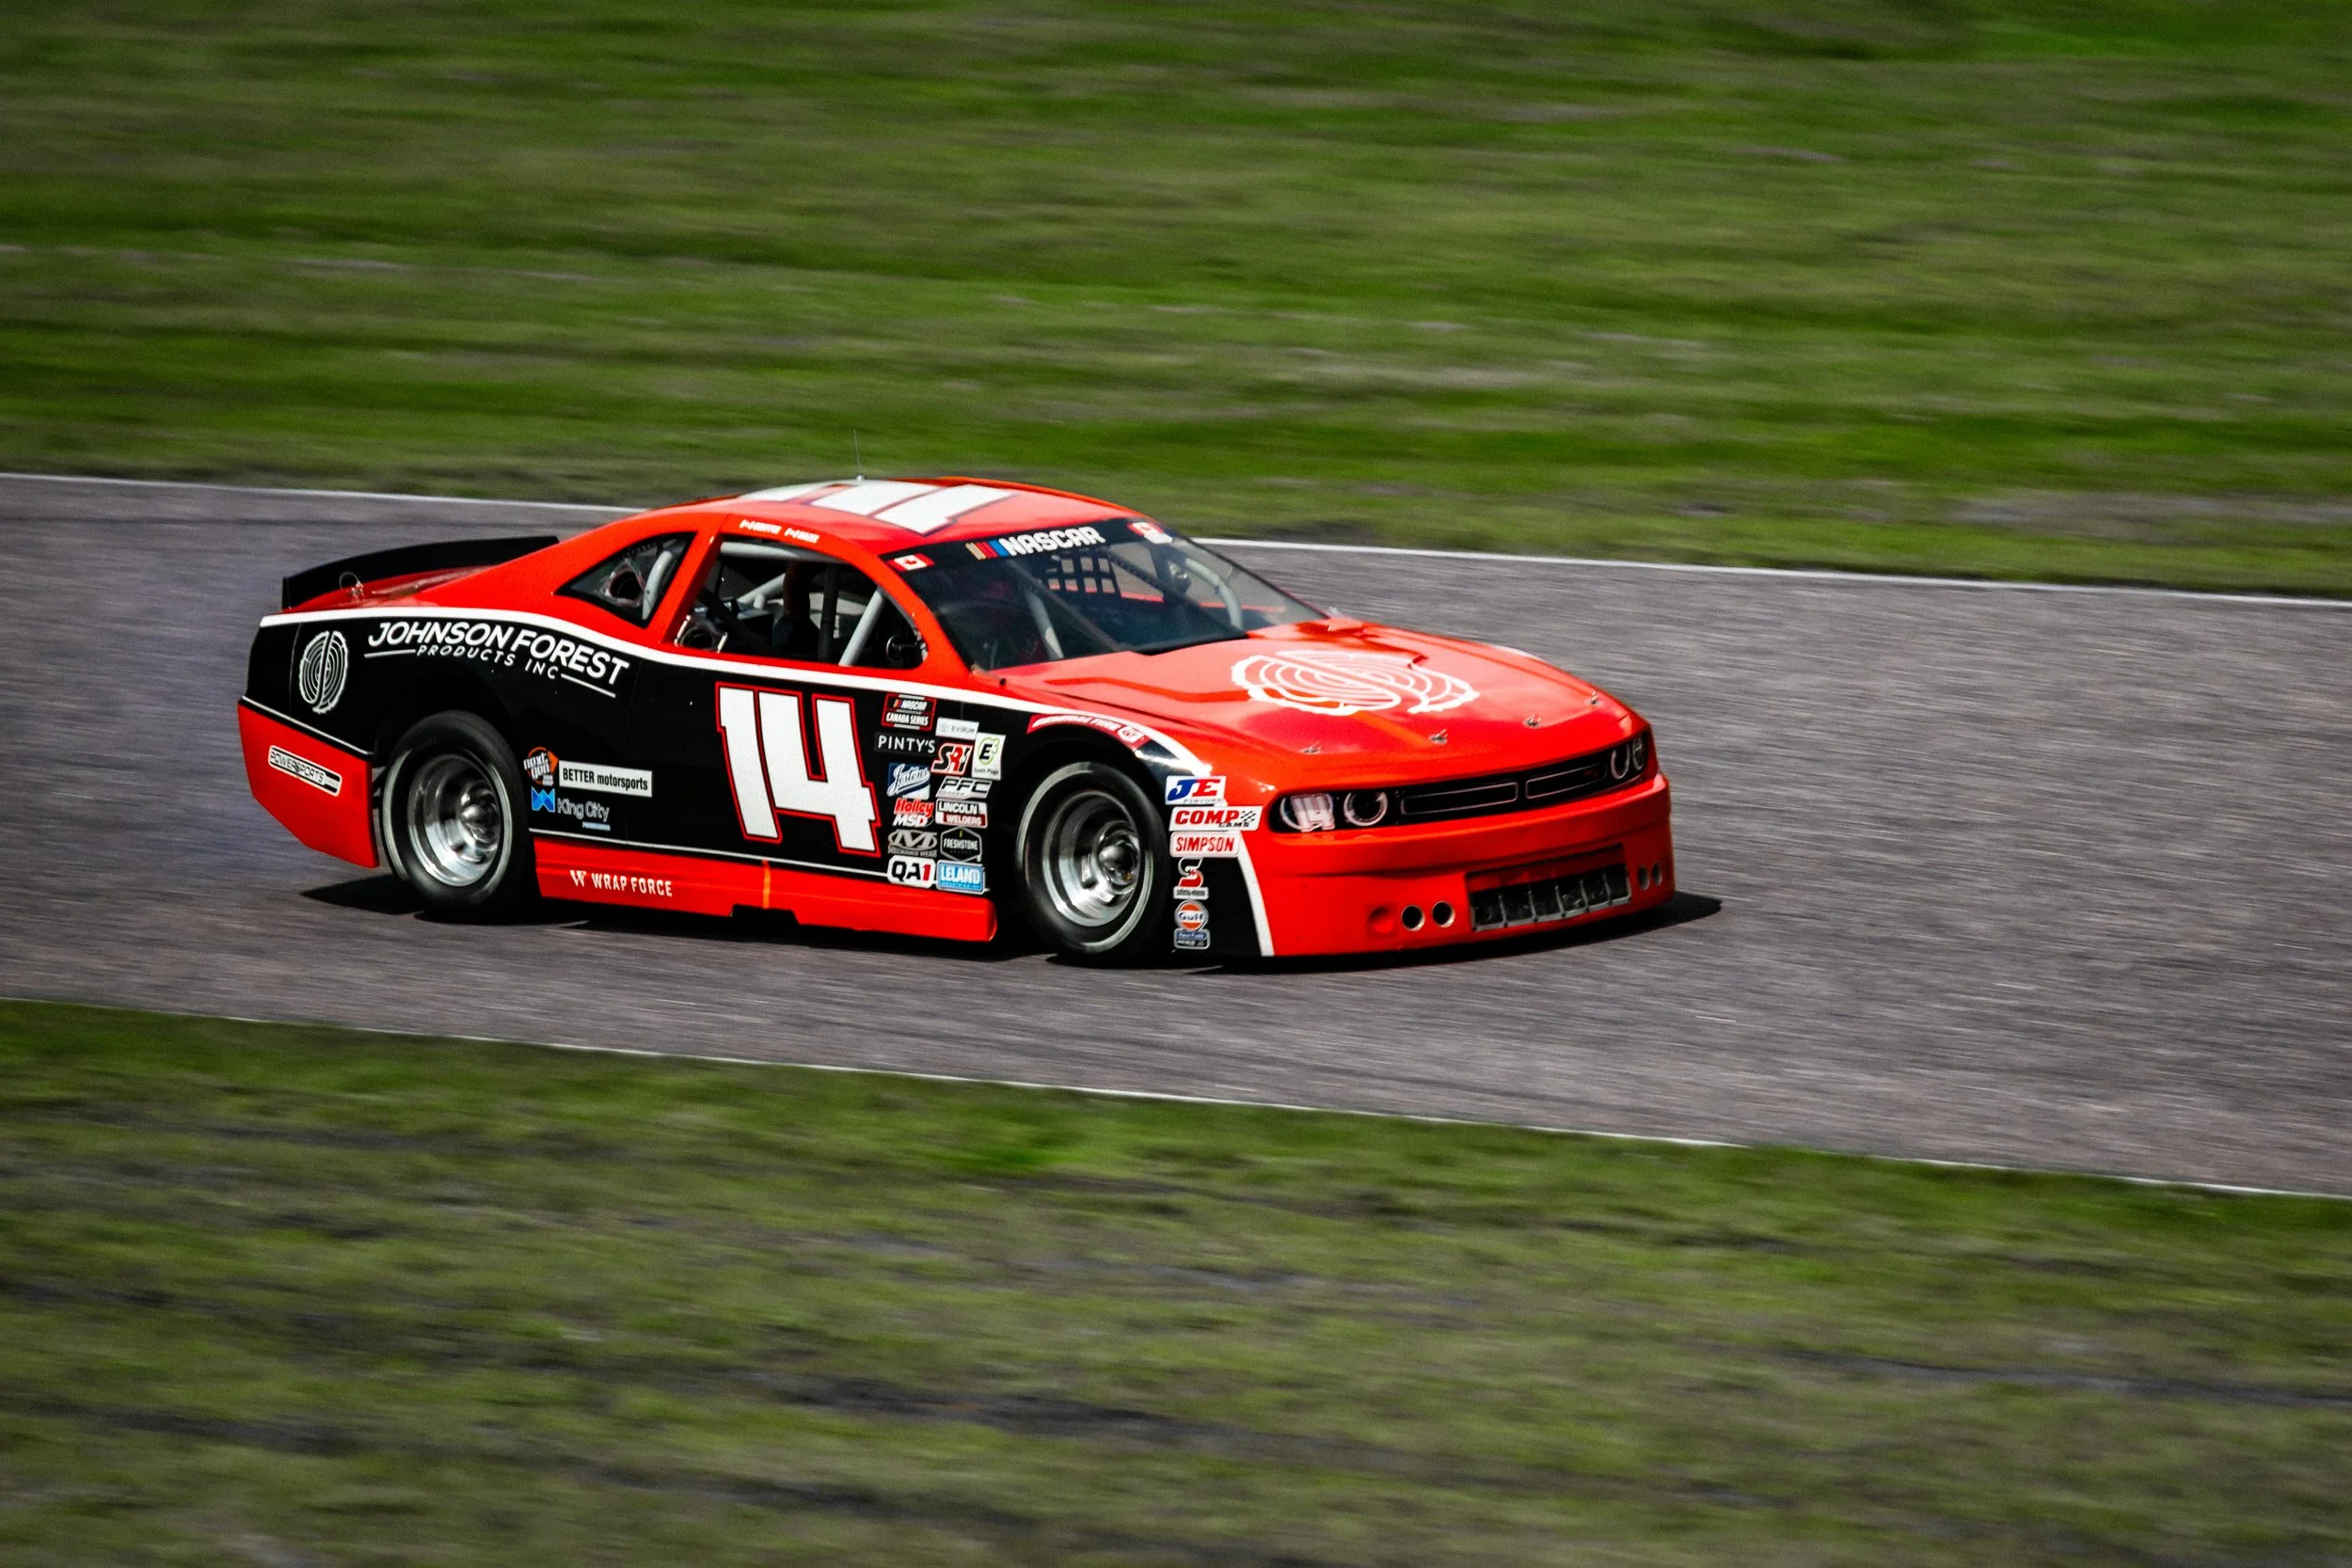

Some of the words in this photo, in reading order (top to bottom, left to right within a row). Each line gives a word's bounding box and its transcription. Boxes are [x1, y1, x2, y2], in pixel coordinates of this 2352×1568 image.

[998, 527, 1106, 556] NASCAR
[368, 621, 514, 649] JOHNSON
[511, 629, 629, 684] FOREST
[417, 644, 516, 666] PRODUCTS
[525, 658, 559, 679] INC
[900, 699, 928, 711] NASCAR
[885, 712, 910, 724] CANADA
[878, 735, 935, 753] PINTY'S
[270, 750, 325, 784] POWERSPORTS
[715, 682, 880, 857] 14
[563, 768, 595, 784] BETTER
[596, 772, 648, 791] motorsports
[941, 777, 992, 795] PFC
[1168, 779, 1221, 801] JE
[557, 798, 584, 820] King
[585, 800, 610, 823] City
[895, 798, 934, 819] Holley
[939, 801, 977, 816] LINCOLN
[1175, 811, 1240, 825] COMP
[893, 814, 930, 828] MSD
[1175, 836, 1235, 852] SIMPSON
[892, 861, 931, 882] QA1
[941, 863, 980, 884] LELAND
[591, 873, 628, 891] WRAP
[630, 877, 673, 896] FORCE
[1179, 911, 1204, 921] Gulf
